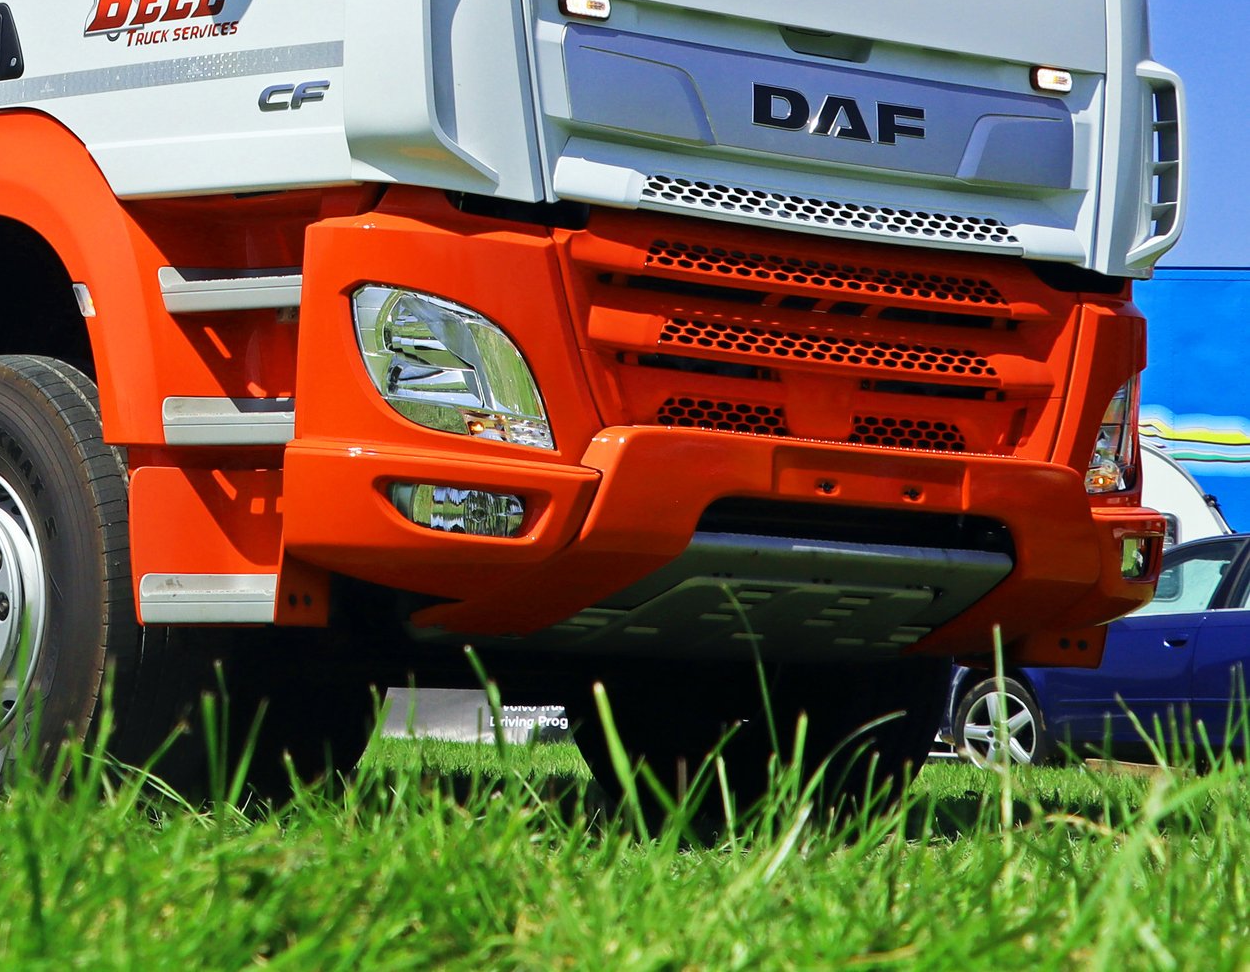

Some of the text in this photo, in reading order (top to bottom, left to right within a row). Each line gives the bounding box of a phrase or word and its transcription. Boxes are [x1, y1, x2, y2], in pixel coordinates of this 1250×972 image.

[127, 20, 239, 47] TRUCK SERVICES
[258, 80, 330, 112] CF
[751, 81, 926, 146] DAF
[538, 715, 569, 730] Prog
